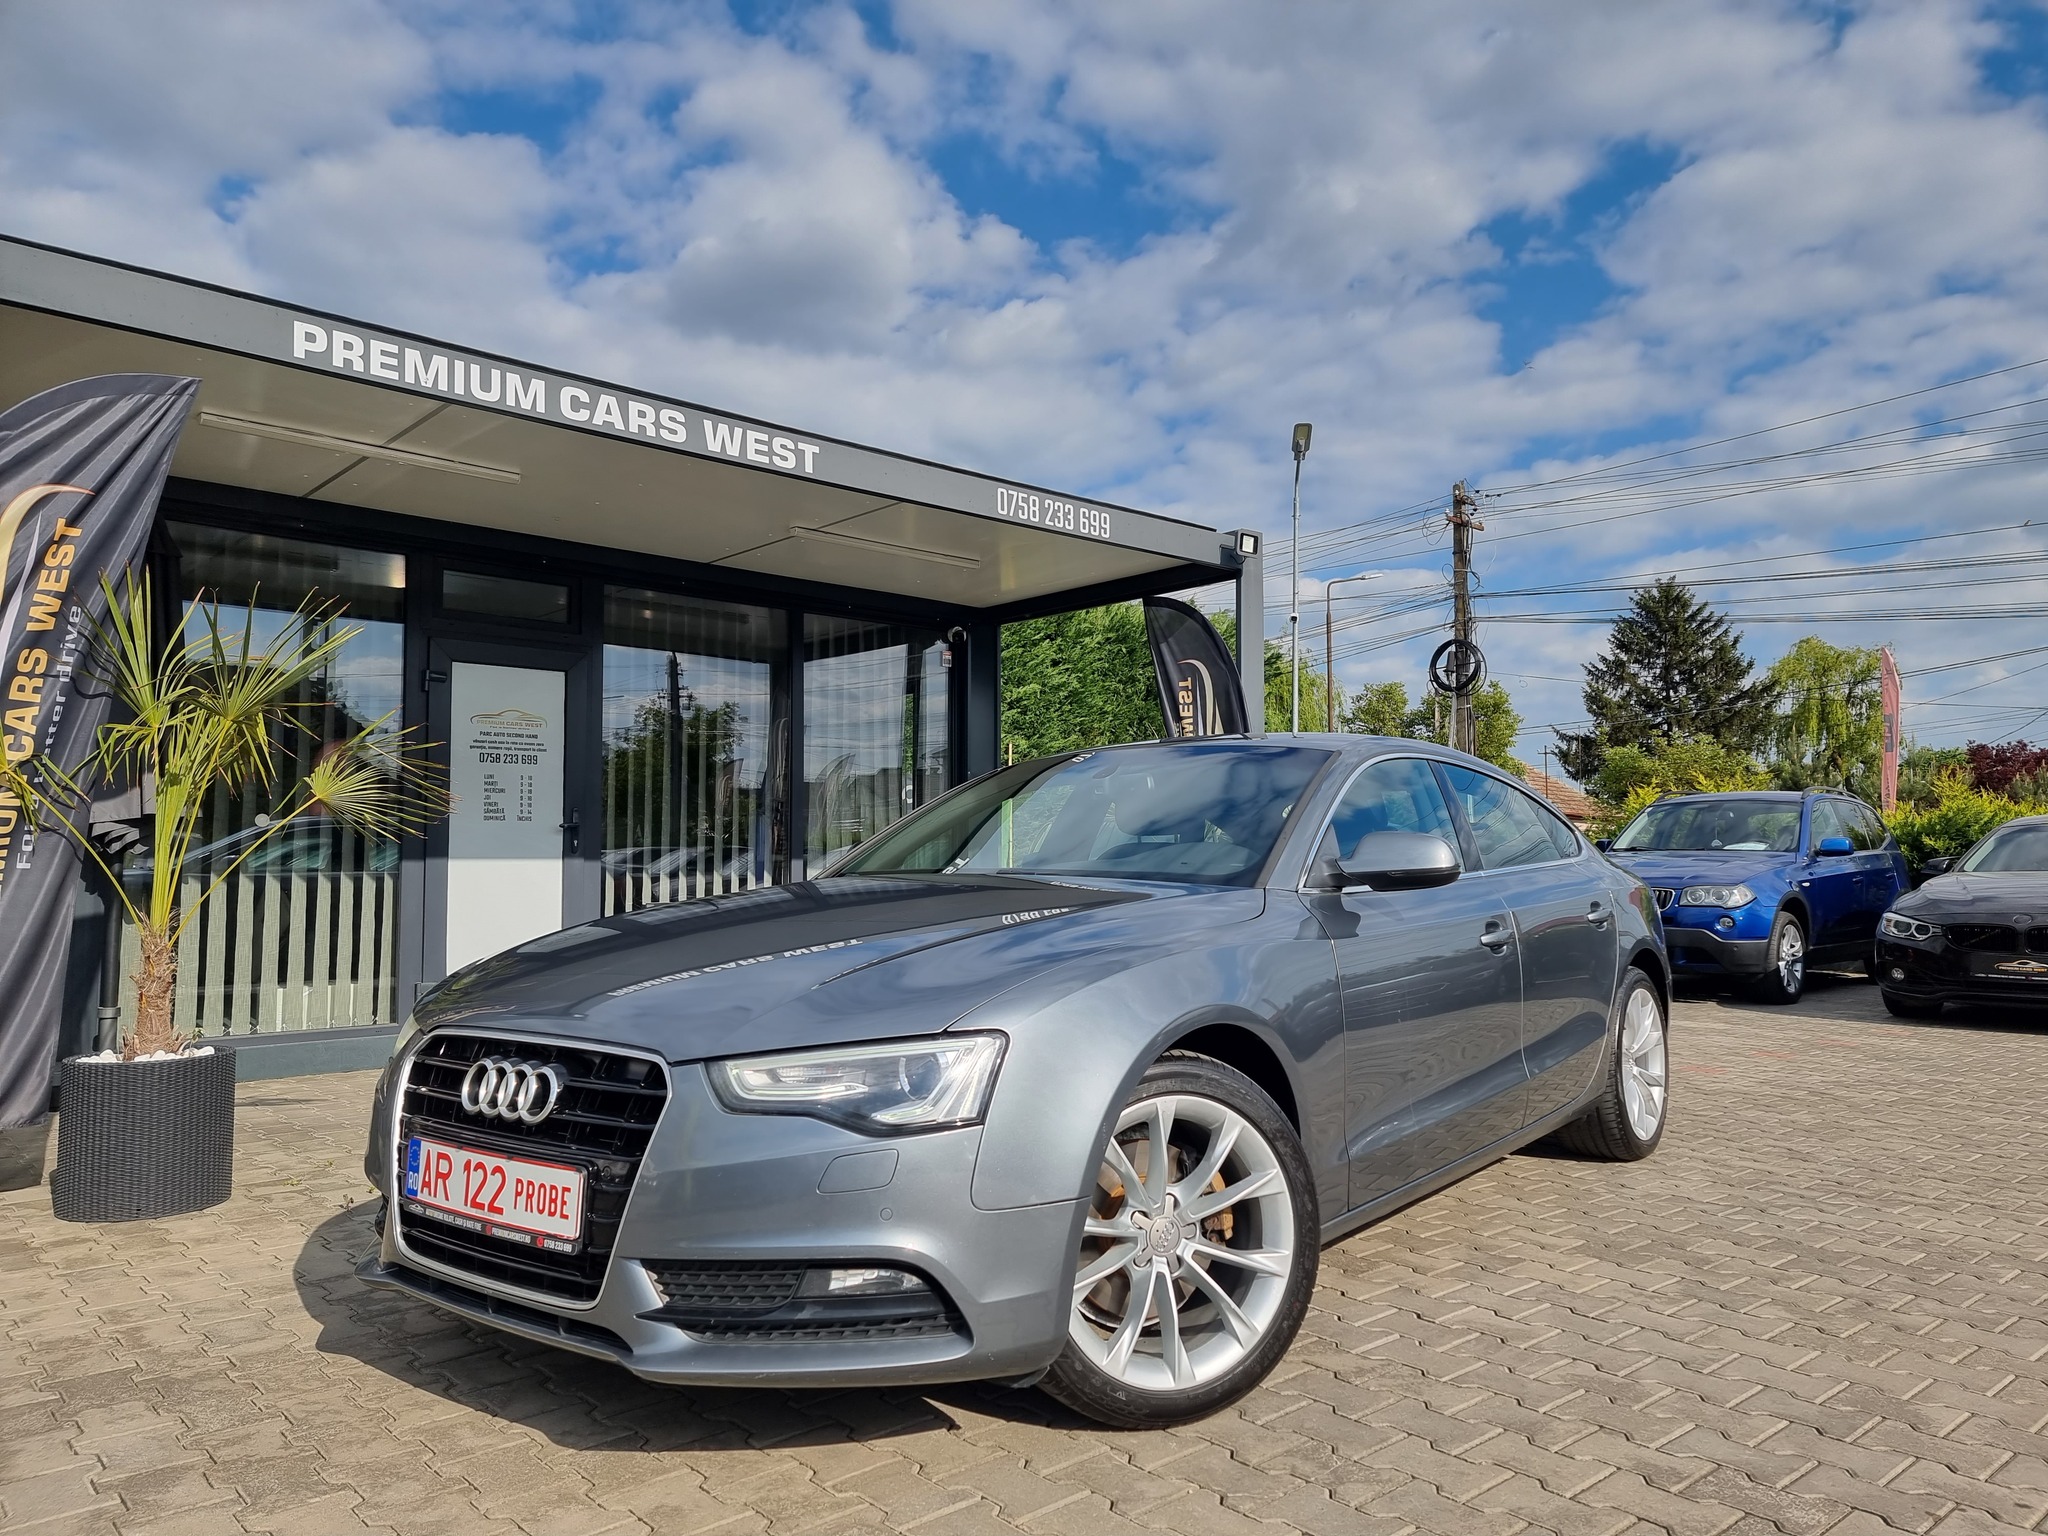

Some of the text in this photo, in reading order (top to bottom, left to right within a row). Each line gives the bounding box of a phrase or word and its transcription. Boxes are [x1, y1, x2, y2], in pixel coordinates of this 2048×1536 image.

[293, 320, 820, 474] PREMIUM CARS WEST
[998, 488, 1110, 538] 0758 233 699
[4, 648, 48, 762] CARS
[26, 518, 82, 631] WEST
[57, 606, 81, 682] drive
[479, 752, 538, 765] 0758 233 699
[408, 1171, 419, 1190] RO
[421, 1148, 571, 1220] AR 122 PROBE
[544, 1239, 554, 1249] 0758
[555, 1241, 563, 1251] 233
